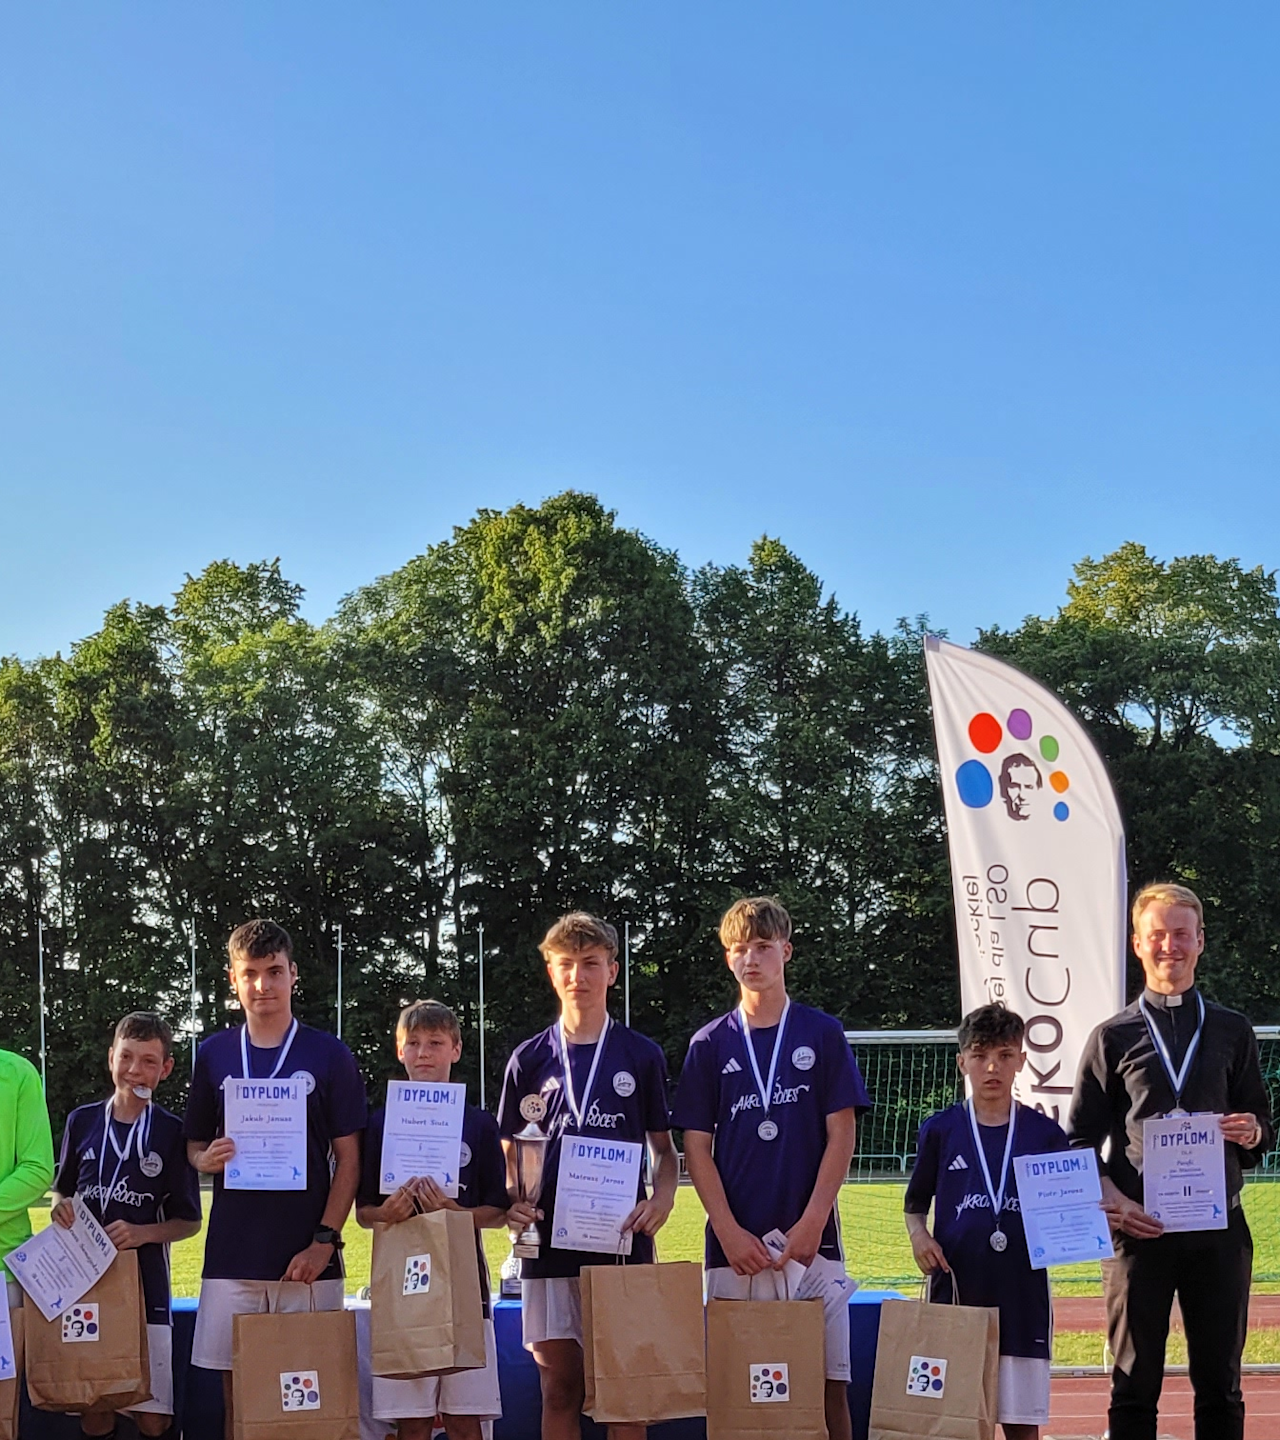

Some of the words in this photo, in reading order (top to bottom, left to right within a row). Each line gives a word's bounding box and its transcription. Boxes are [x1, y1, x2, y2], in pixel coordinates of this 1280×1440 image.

[243, 1086, 291, 1100] DYPLOM
[403, 1089, 450, 1105] DYPLOM
[1161, 1131, 1208, 1147] DYPLOM
[578, 1144, 626, 1162] DYPLOM
[1032, 1158, 1081, 1176] DYPLOM
[80, 1209, 108, 1252] DYPLOM
